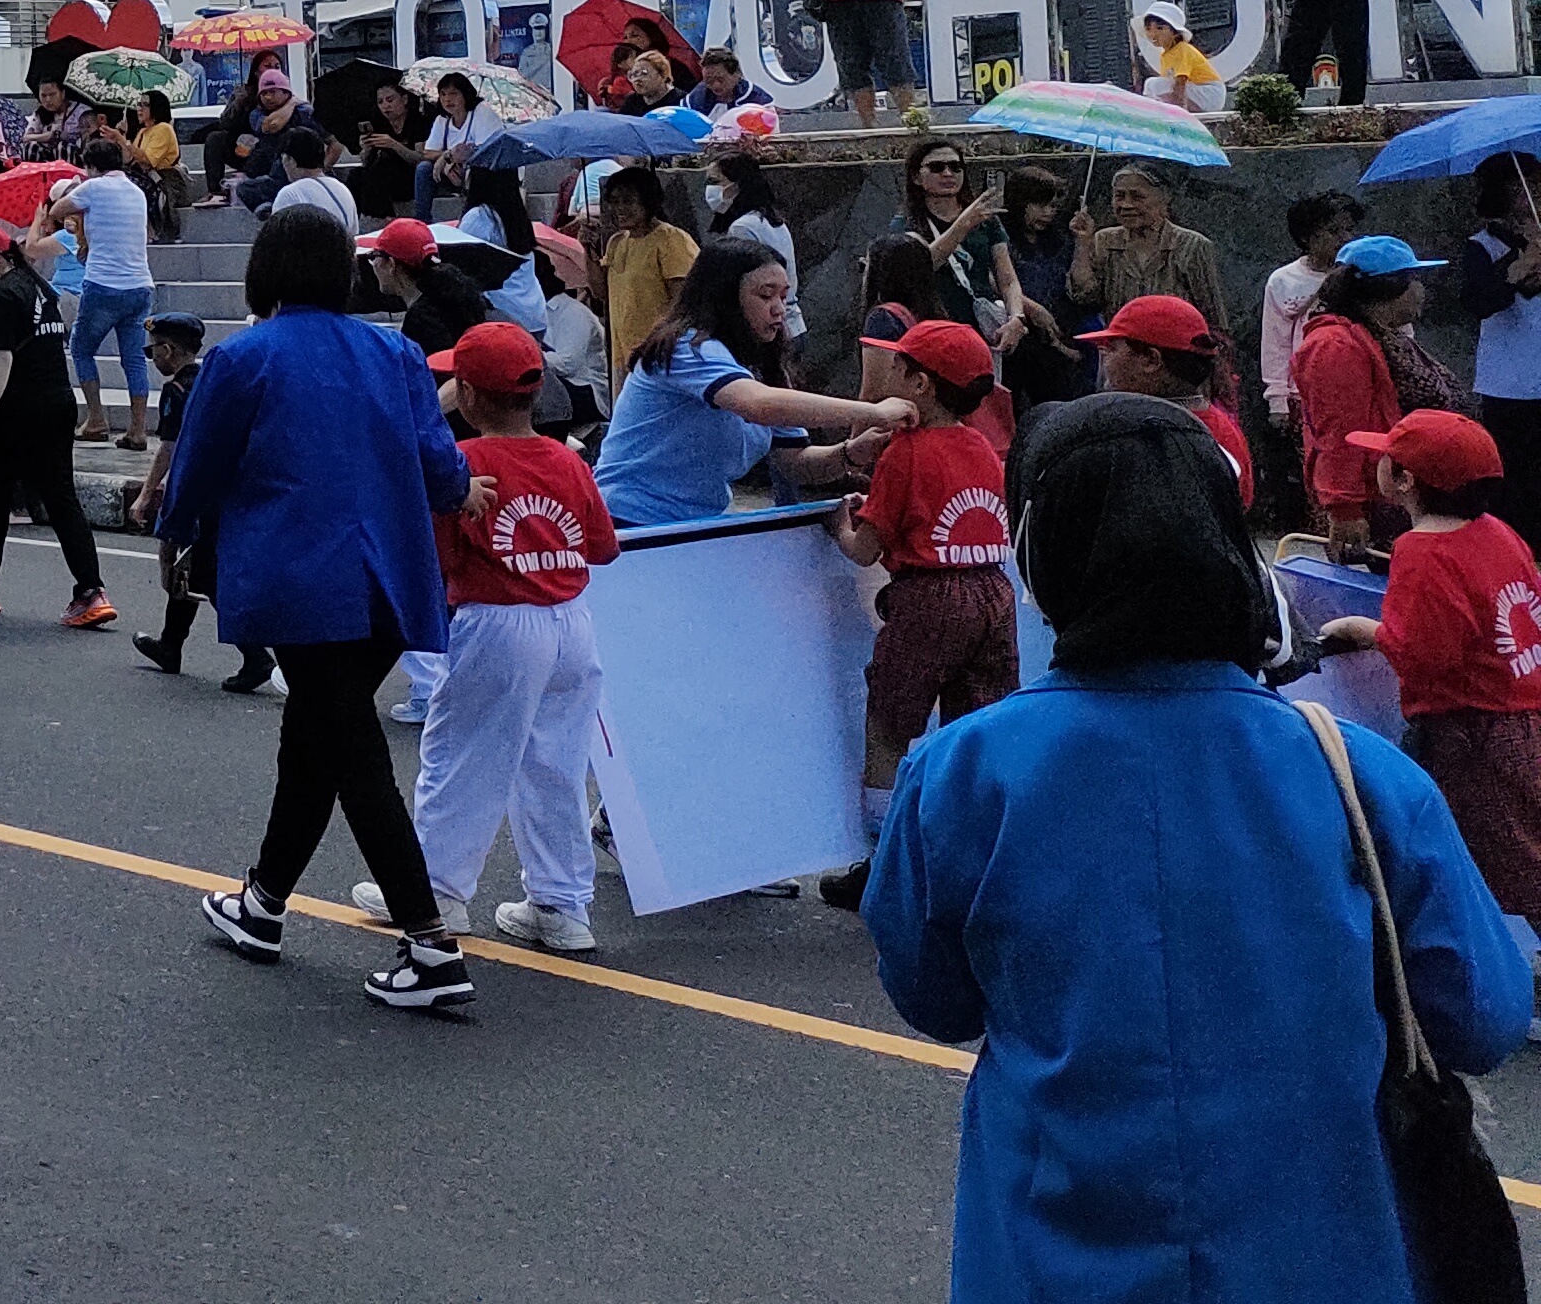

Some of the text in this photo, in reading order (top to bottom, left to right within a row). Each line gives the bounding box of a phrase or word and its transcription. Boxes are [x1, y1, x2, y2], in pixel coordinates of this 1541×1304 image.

[494, 495, 530, 536] KATOLIK
[527, 493, 564, 523] SANTA
[492, 535, 514, 551] SD
[930, 525, 950, 542] SD
